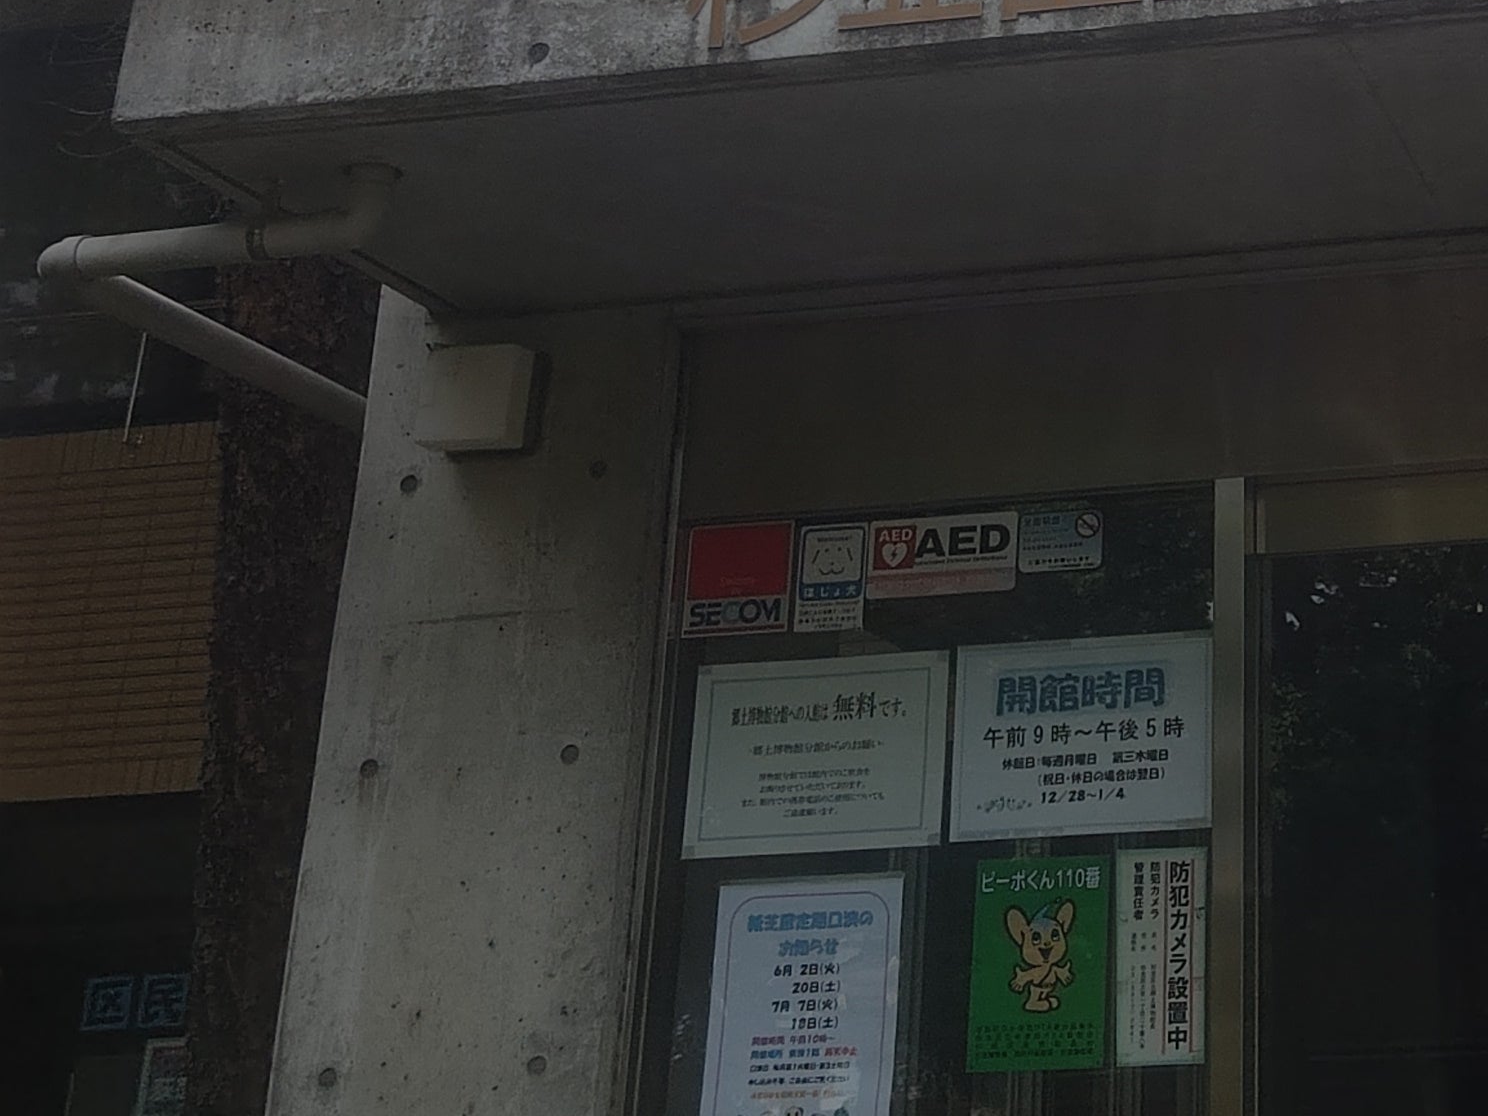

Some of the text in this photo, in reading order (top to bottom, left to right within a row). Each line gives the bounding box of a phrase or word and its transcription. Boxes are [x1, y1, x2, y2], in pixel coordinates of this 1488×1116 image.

[879, 529, 913, 542] AED
[916, 524, 1012, 558] AED
[689, 598, 782, 628] SECOM
[995, 667, 1166, 716] 開館時間
[981, 866, 1101, 893] ピーポくん110番
[1149, 862, 1161, 920] 防犯カメラ
[778, 938, 839, 957] お知らせ
[1167, 861, 1191, 1051] 防犯カメラ設置中
[774, 964, 792, 976] 6月
[792, 980, 841, 994] 20日(土)
[771, 1000, 790, 1012] 7月
